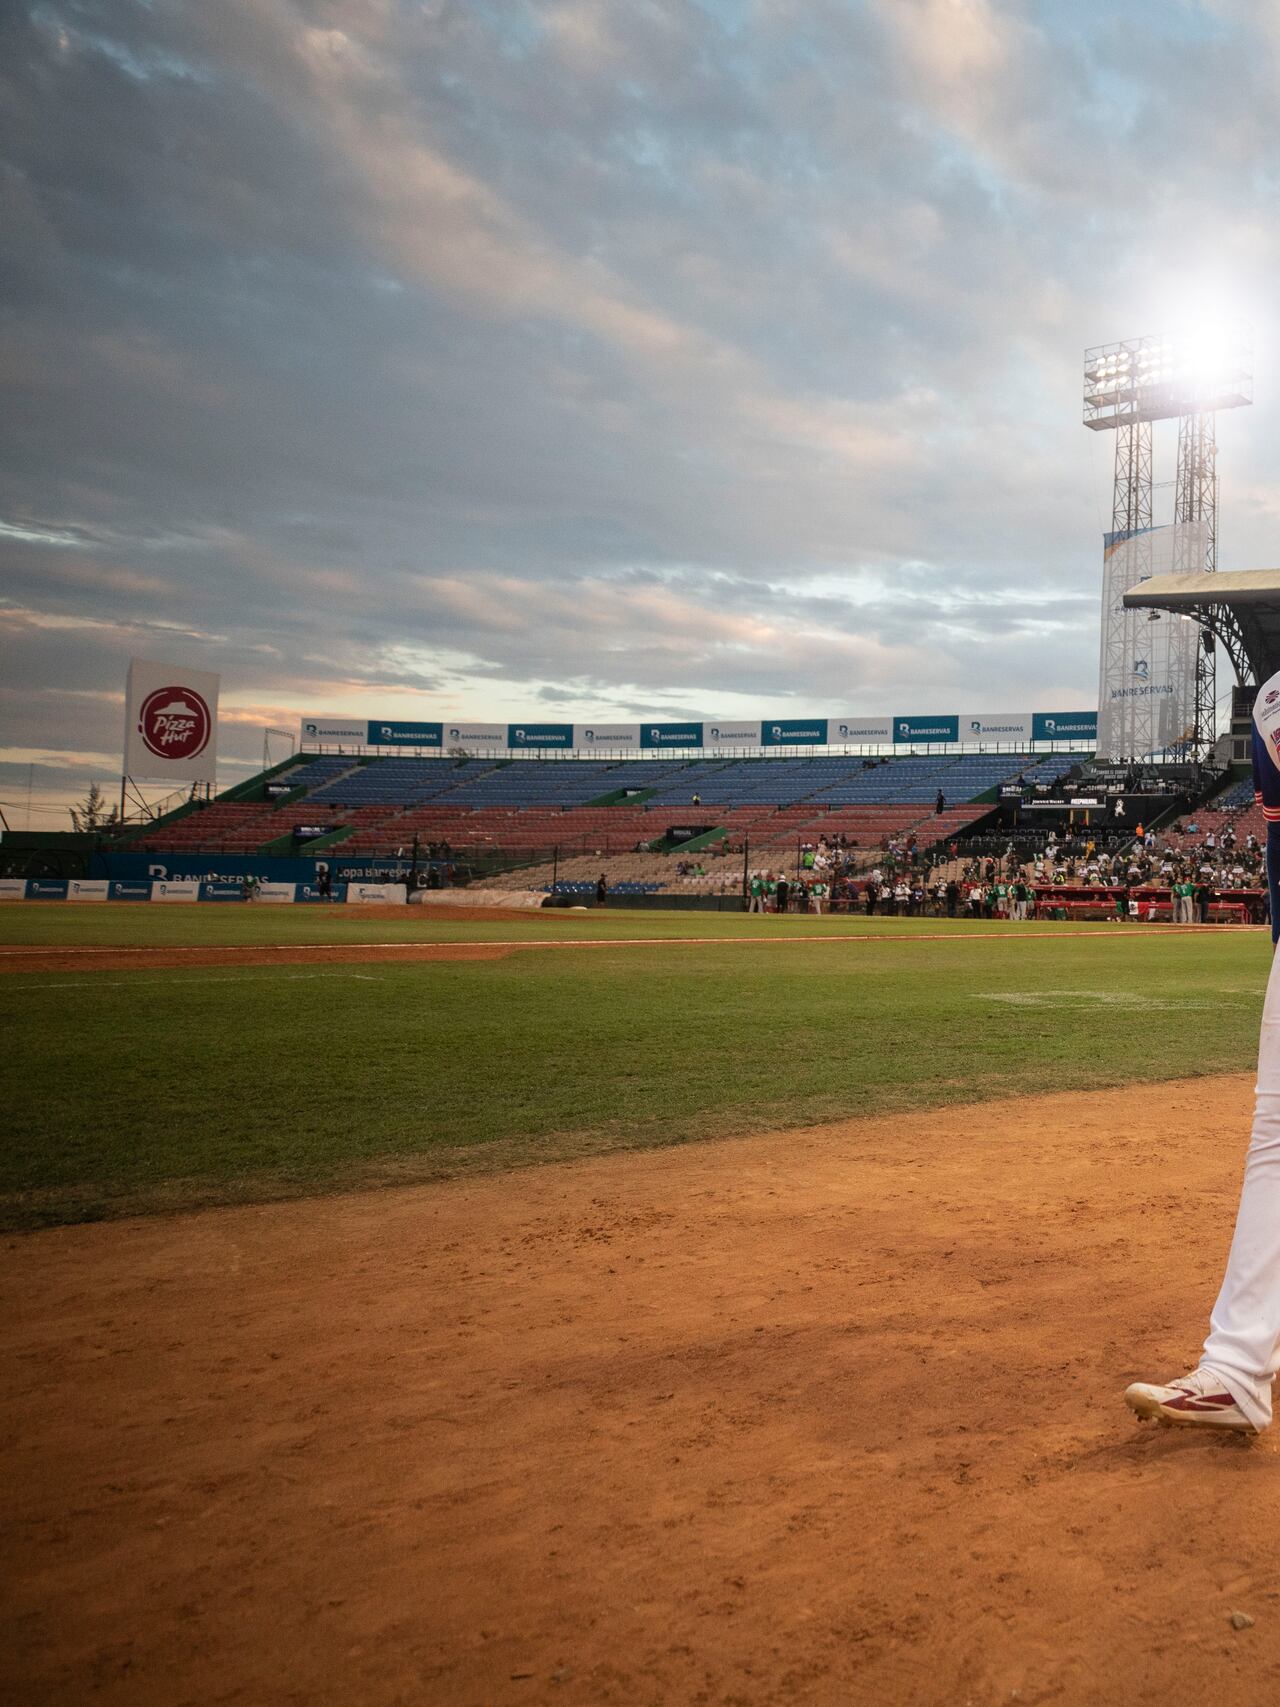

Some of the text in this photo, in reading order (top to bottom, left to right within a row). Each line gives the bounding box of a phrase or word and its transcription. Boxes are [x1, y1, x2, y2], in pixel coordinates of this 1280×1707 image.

[1111, 684, 1173, 698] BANRESERVAS
[153, 715, 196, 734] Pizza
[1056, 724, 1097, 732] BANRESERVA
[319, 729, 364, 737] BANRESERVAS
[910, 727, 951, 735] BANRESERVAS
[981, 725, 1024, 733] BANRESERVAS
[160, 730, 193, 745] Hut
[393, 732, 437, 740] BANRESERVAS
[461, 733, 503, 741] BANRESERVAS
[660, 733, 697, 741] BANRESERVAS
[782, 730, 820, 738] BANRESERVAS
